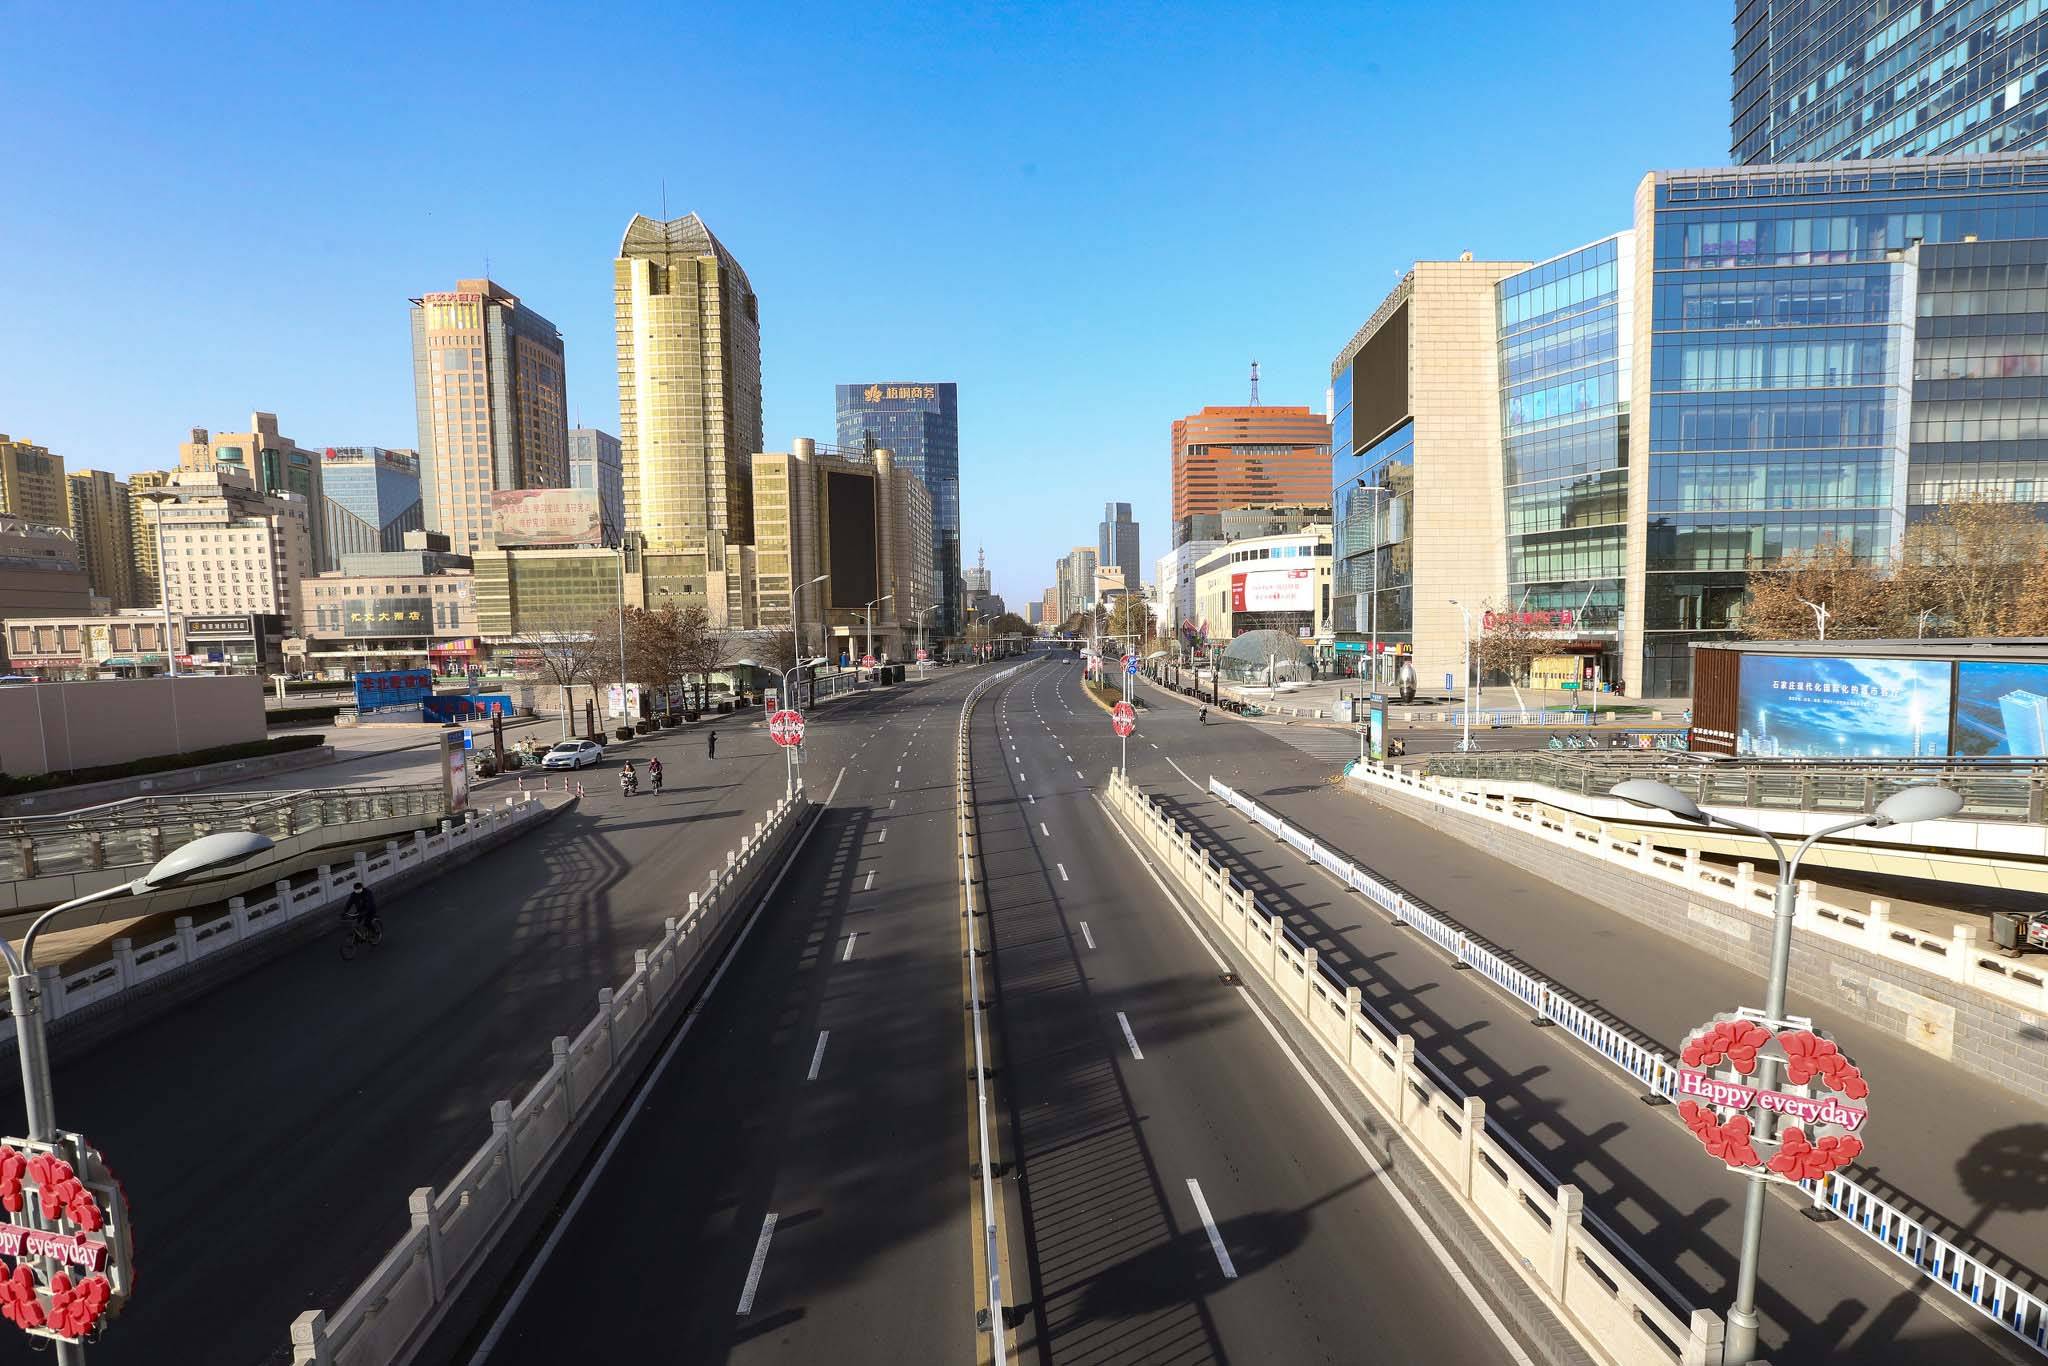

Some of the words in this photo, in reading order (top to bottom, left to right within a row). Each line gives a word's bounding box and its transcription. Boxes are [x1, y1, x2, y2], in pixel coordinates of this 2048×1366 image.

[886, 387, 935, 399] 梧桐商务
[351, 612, 421, 622] 汇文大酒店
[1682, 1073, 1754, 1107] Happy
[1760, 1094, 1864, 1130] everyday
[27, 1238, 98, 1271] everyday
